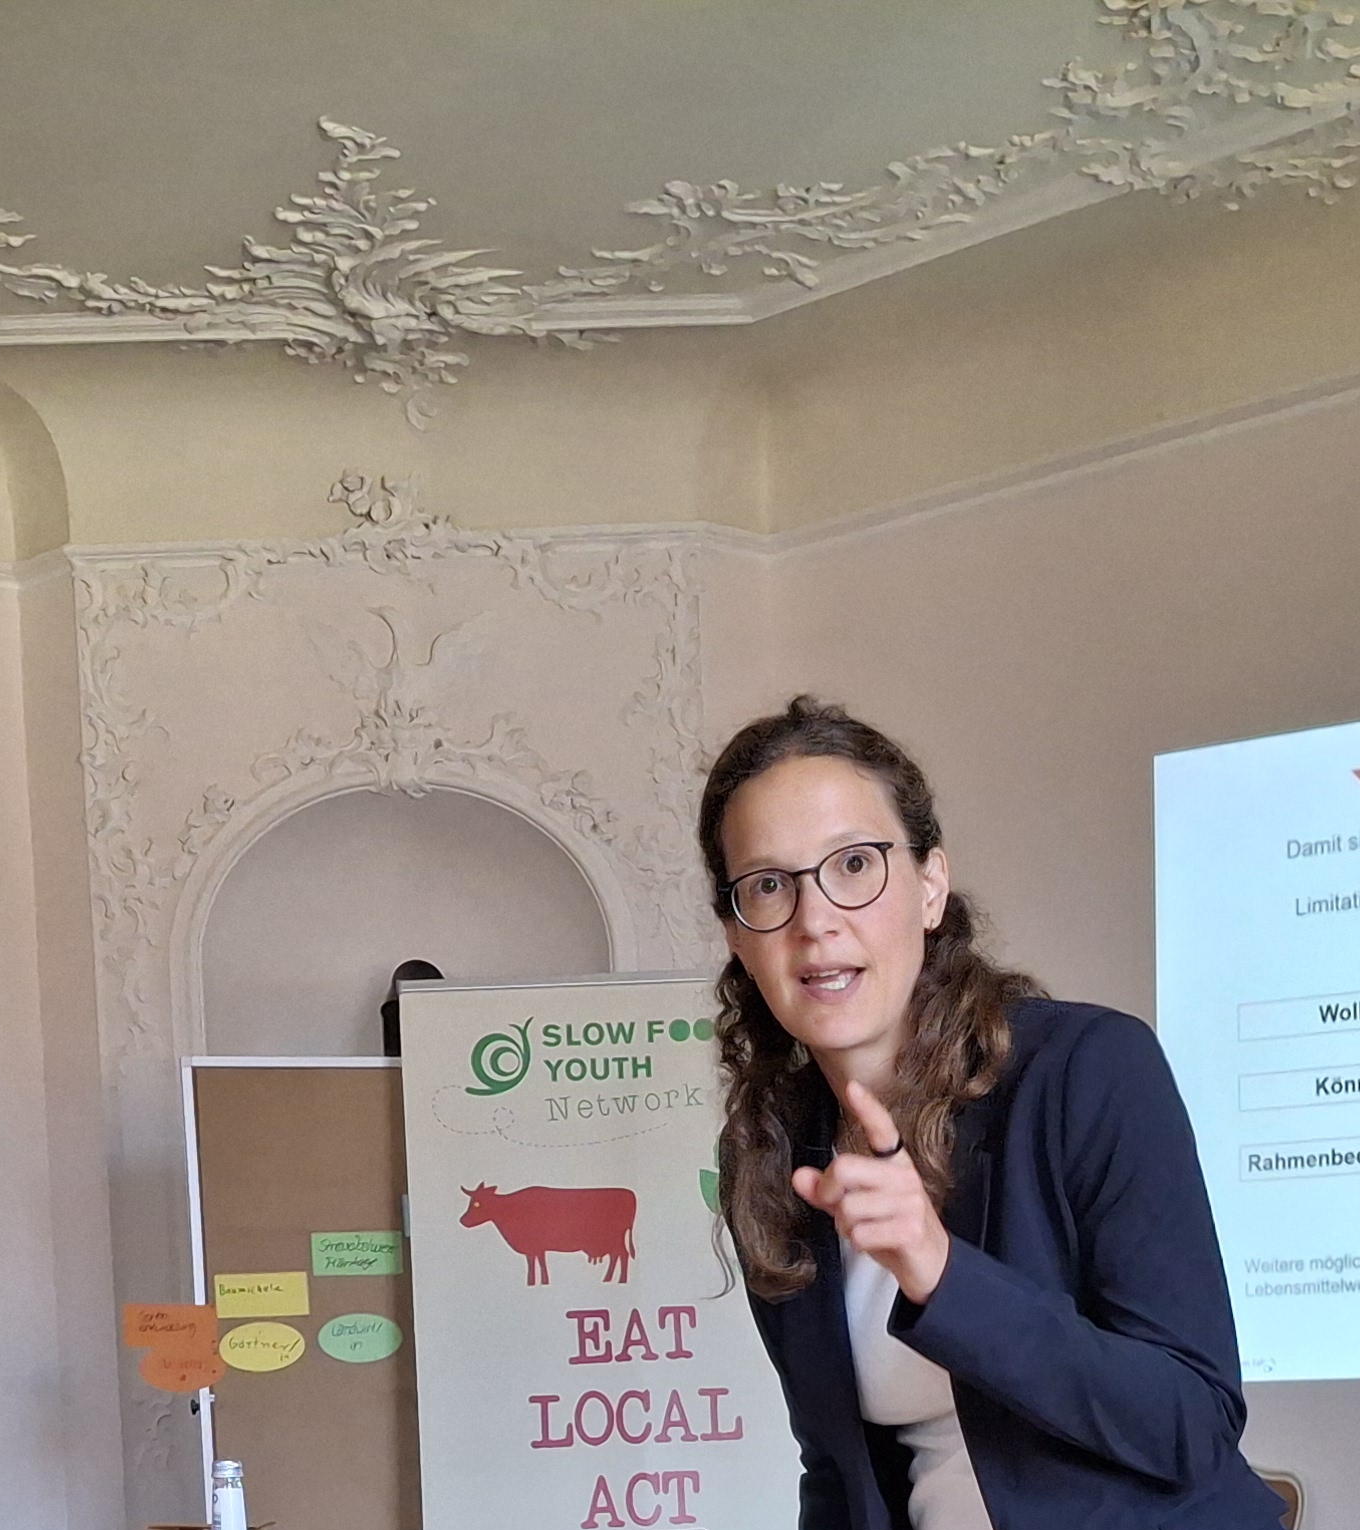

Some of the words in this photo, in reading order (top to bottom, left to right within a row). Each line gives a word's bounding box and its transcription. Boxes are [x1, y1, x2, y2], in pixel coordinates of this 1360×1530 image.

[1287, 836, 1342, 859] Damit
[542, 1020, 636, 1047] SLOW
[543, 1056, 653, 1084] YOUTH
[545, 1083, 705, 1123] Network
[1245, 1258, 1305, 1275] Weitere
[566, 1305, 697, 1365] EAT
[528, 1387, 744, 1450] LOCAL
[580, 1470, 700, 1530] ACT
